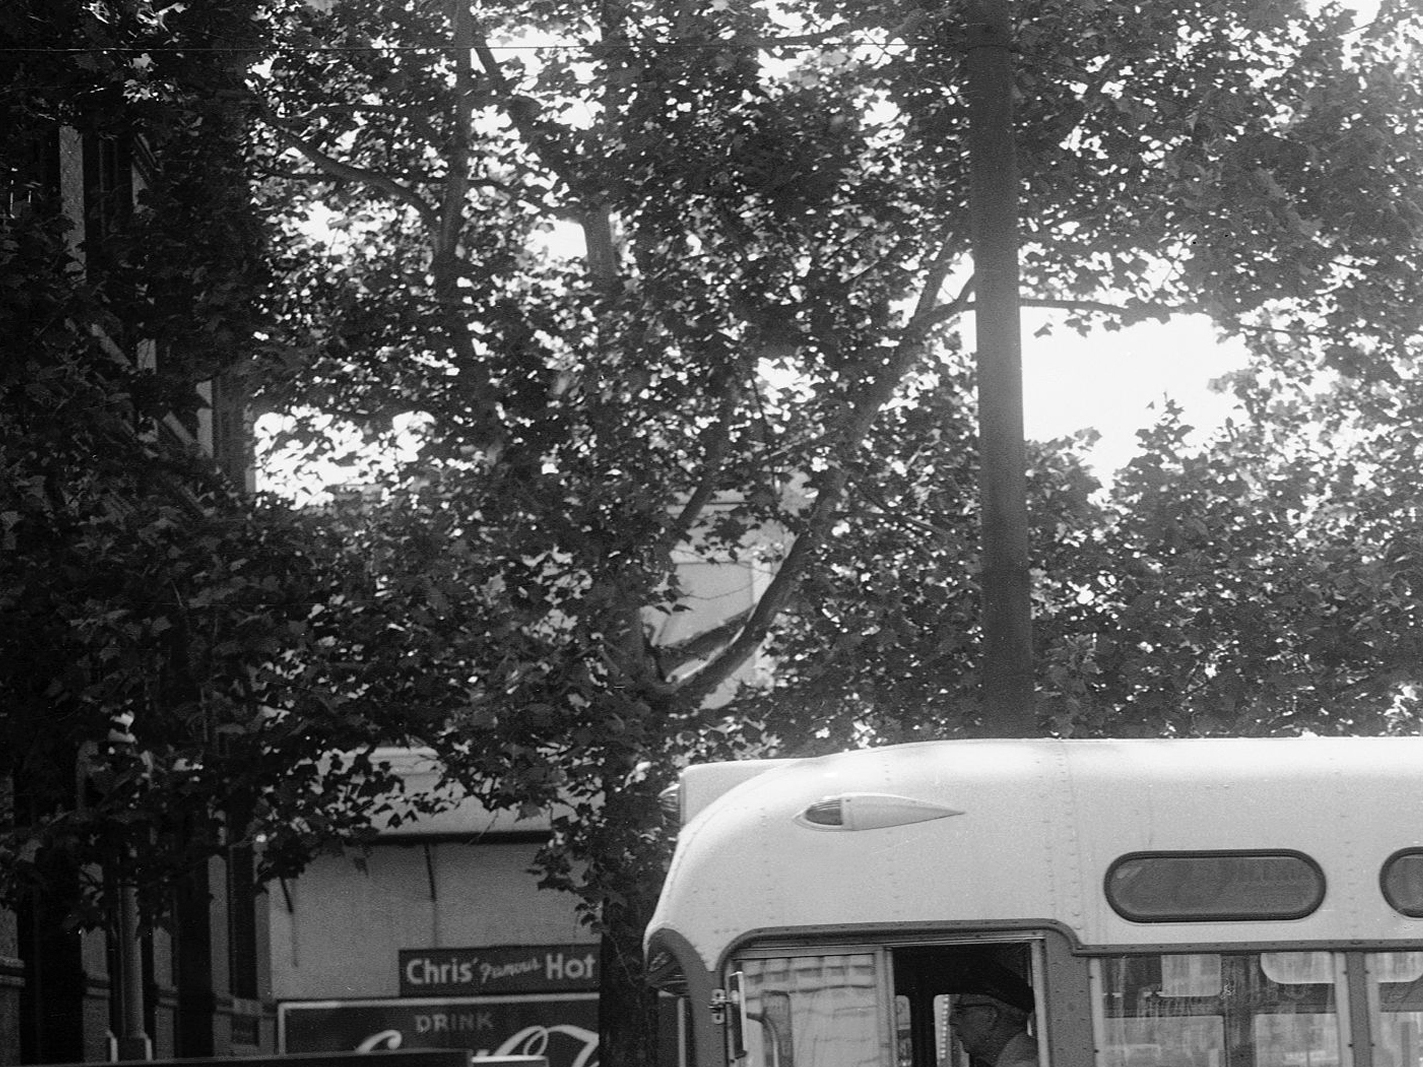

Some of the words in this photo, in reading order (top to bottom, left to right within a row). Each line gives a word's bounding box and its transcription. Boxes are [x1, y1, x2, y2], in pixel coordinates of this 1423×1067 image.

[406, 957, 479, 985] Chris'
[546, 953, 596, 980] Hot
[414, 1012, 493, 1033] DRINK
